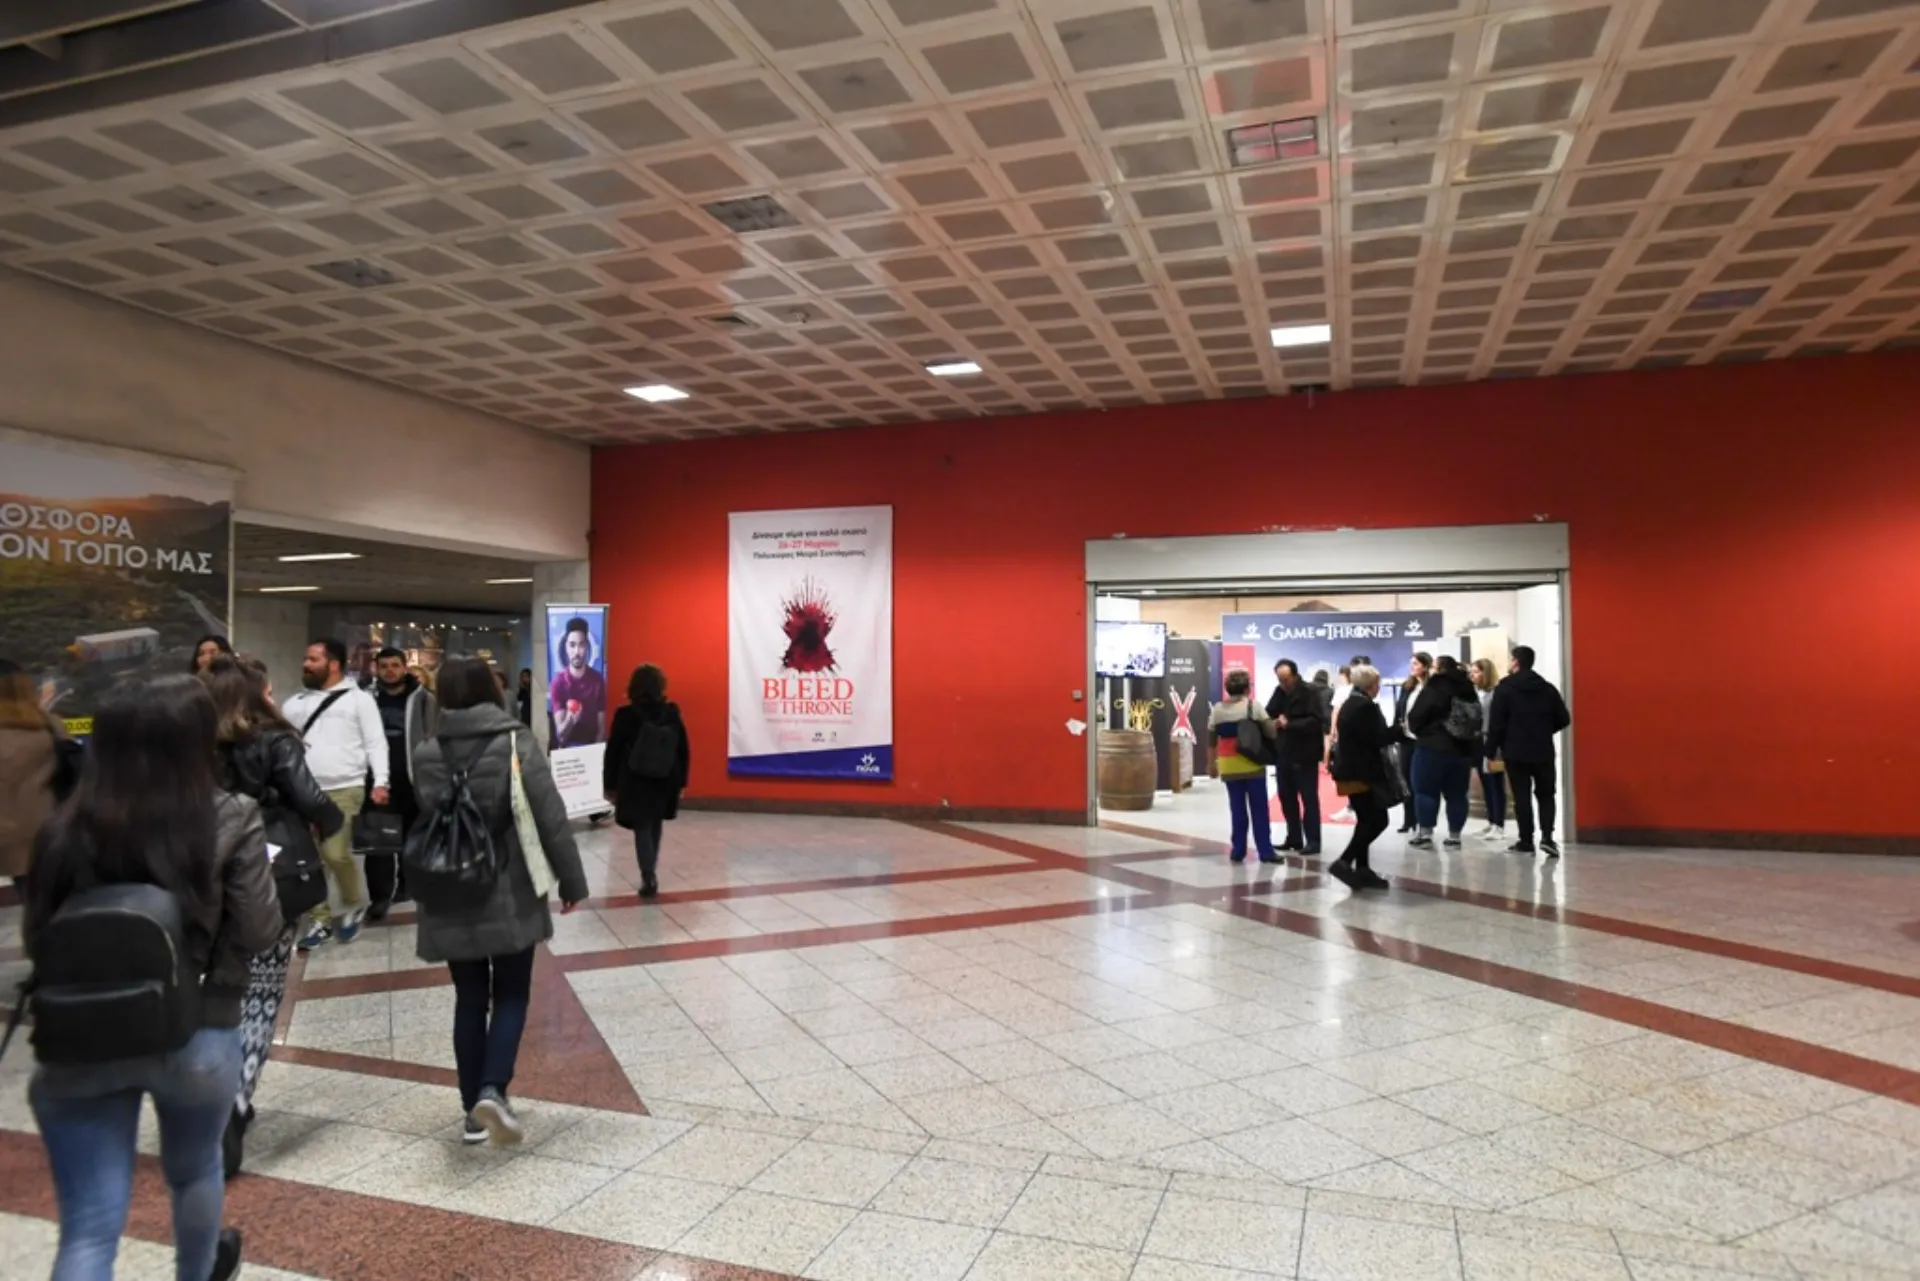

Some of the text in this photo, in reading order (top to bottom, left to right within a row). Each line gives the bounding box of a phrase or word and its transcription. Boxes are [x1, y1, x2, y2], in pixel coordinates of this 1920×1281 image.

[58, 538, 148, 568] ΤΟΠΟ
[156, 548, 212, 574] ΜΑΣ
[1268, 624, 1315, 640] GAME
[1323, 622, 1396, 640] THRONES
[762, 677, 854, 700] BLEED
[781, 701, 854, 715] THRONE
